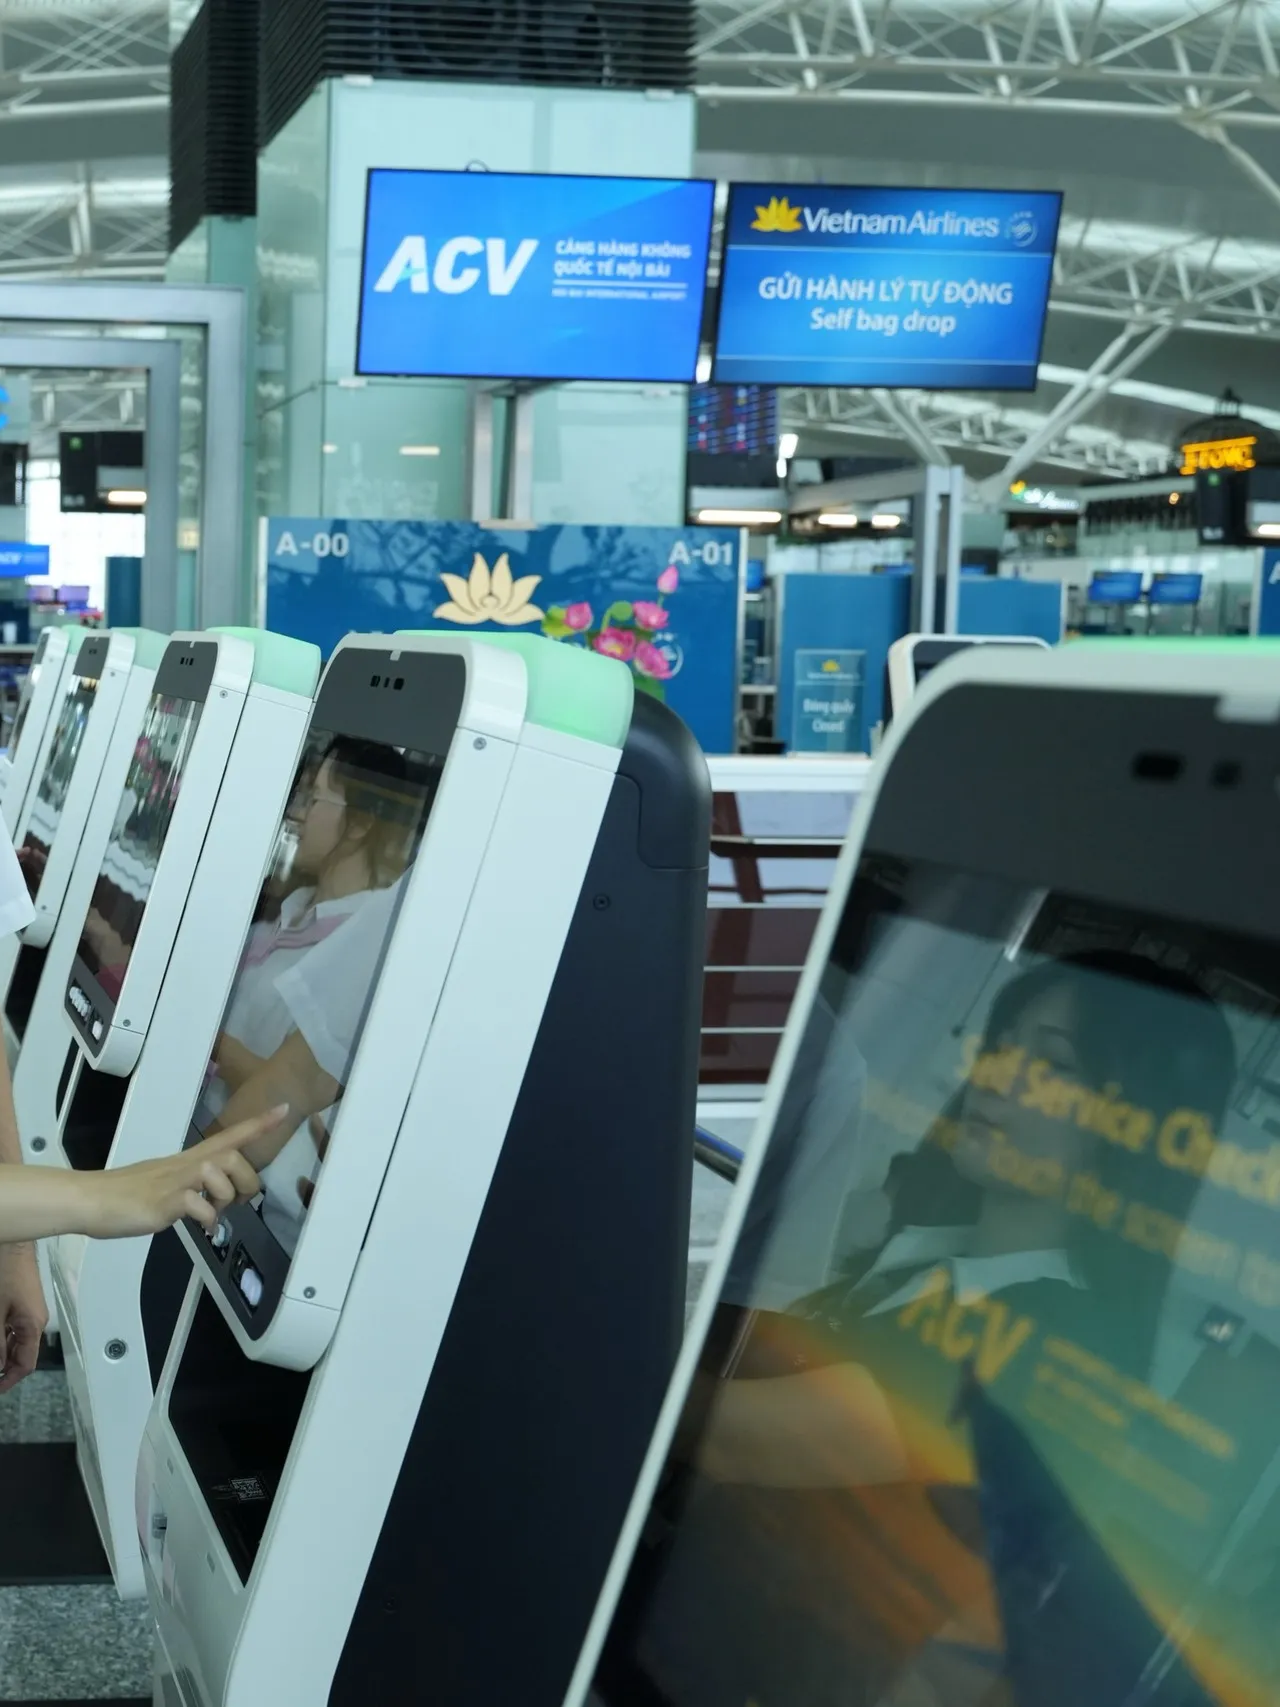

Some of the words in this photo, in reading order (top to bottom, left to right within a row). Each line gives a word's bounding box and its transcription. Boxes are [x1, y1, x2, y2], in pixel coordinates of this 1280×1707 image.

[803, 206, 908, 234] Vietnam
[907, 210, 1000, 238] Airlines
[373, 236, 539, 296] ACV
[759, 271, 801, 300] GỬI
[807, 272, 874, 301] HÀNH
[879, 275, 904, 302] LÝ
[908, 278, 940, 308] TỰ
[943, 278, 1013, 308] ĐỘNG
[810, 307, 852, 330] Self
[856, 309, 900, 336] bag
[903, 311, 957, 337] drop
[275, 531, 349, 557] A-00
[668, 541, 733, 566] A-01
[957, 1033, 1027, 1096] Self
[1019, 1059, 1156, 1153] Service
[898, 1267, 1037, 1385] ACV
